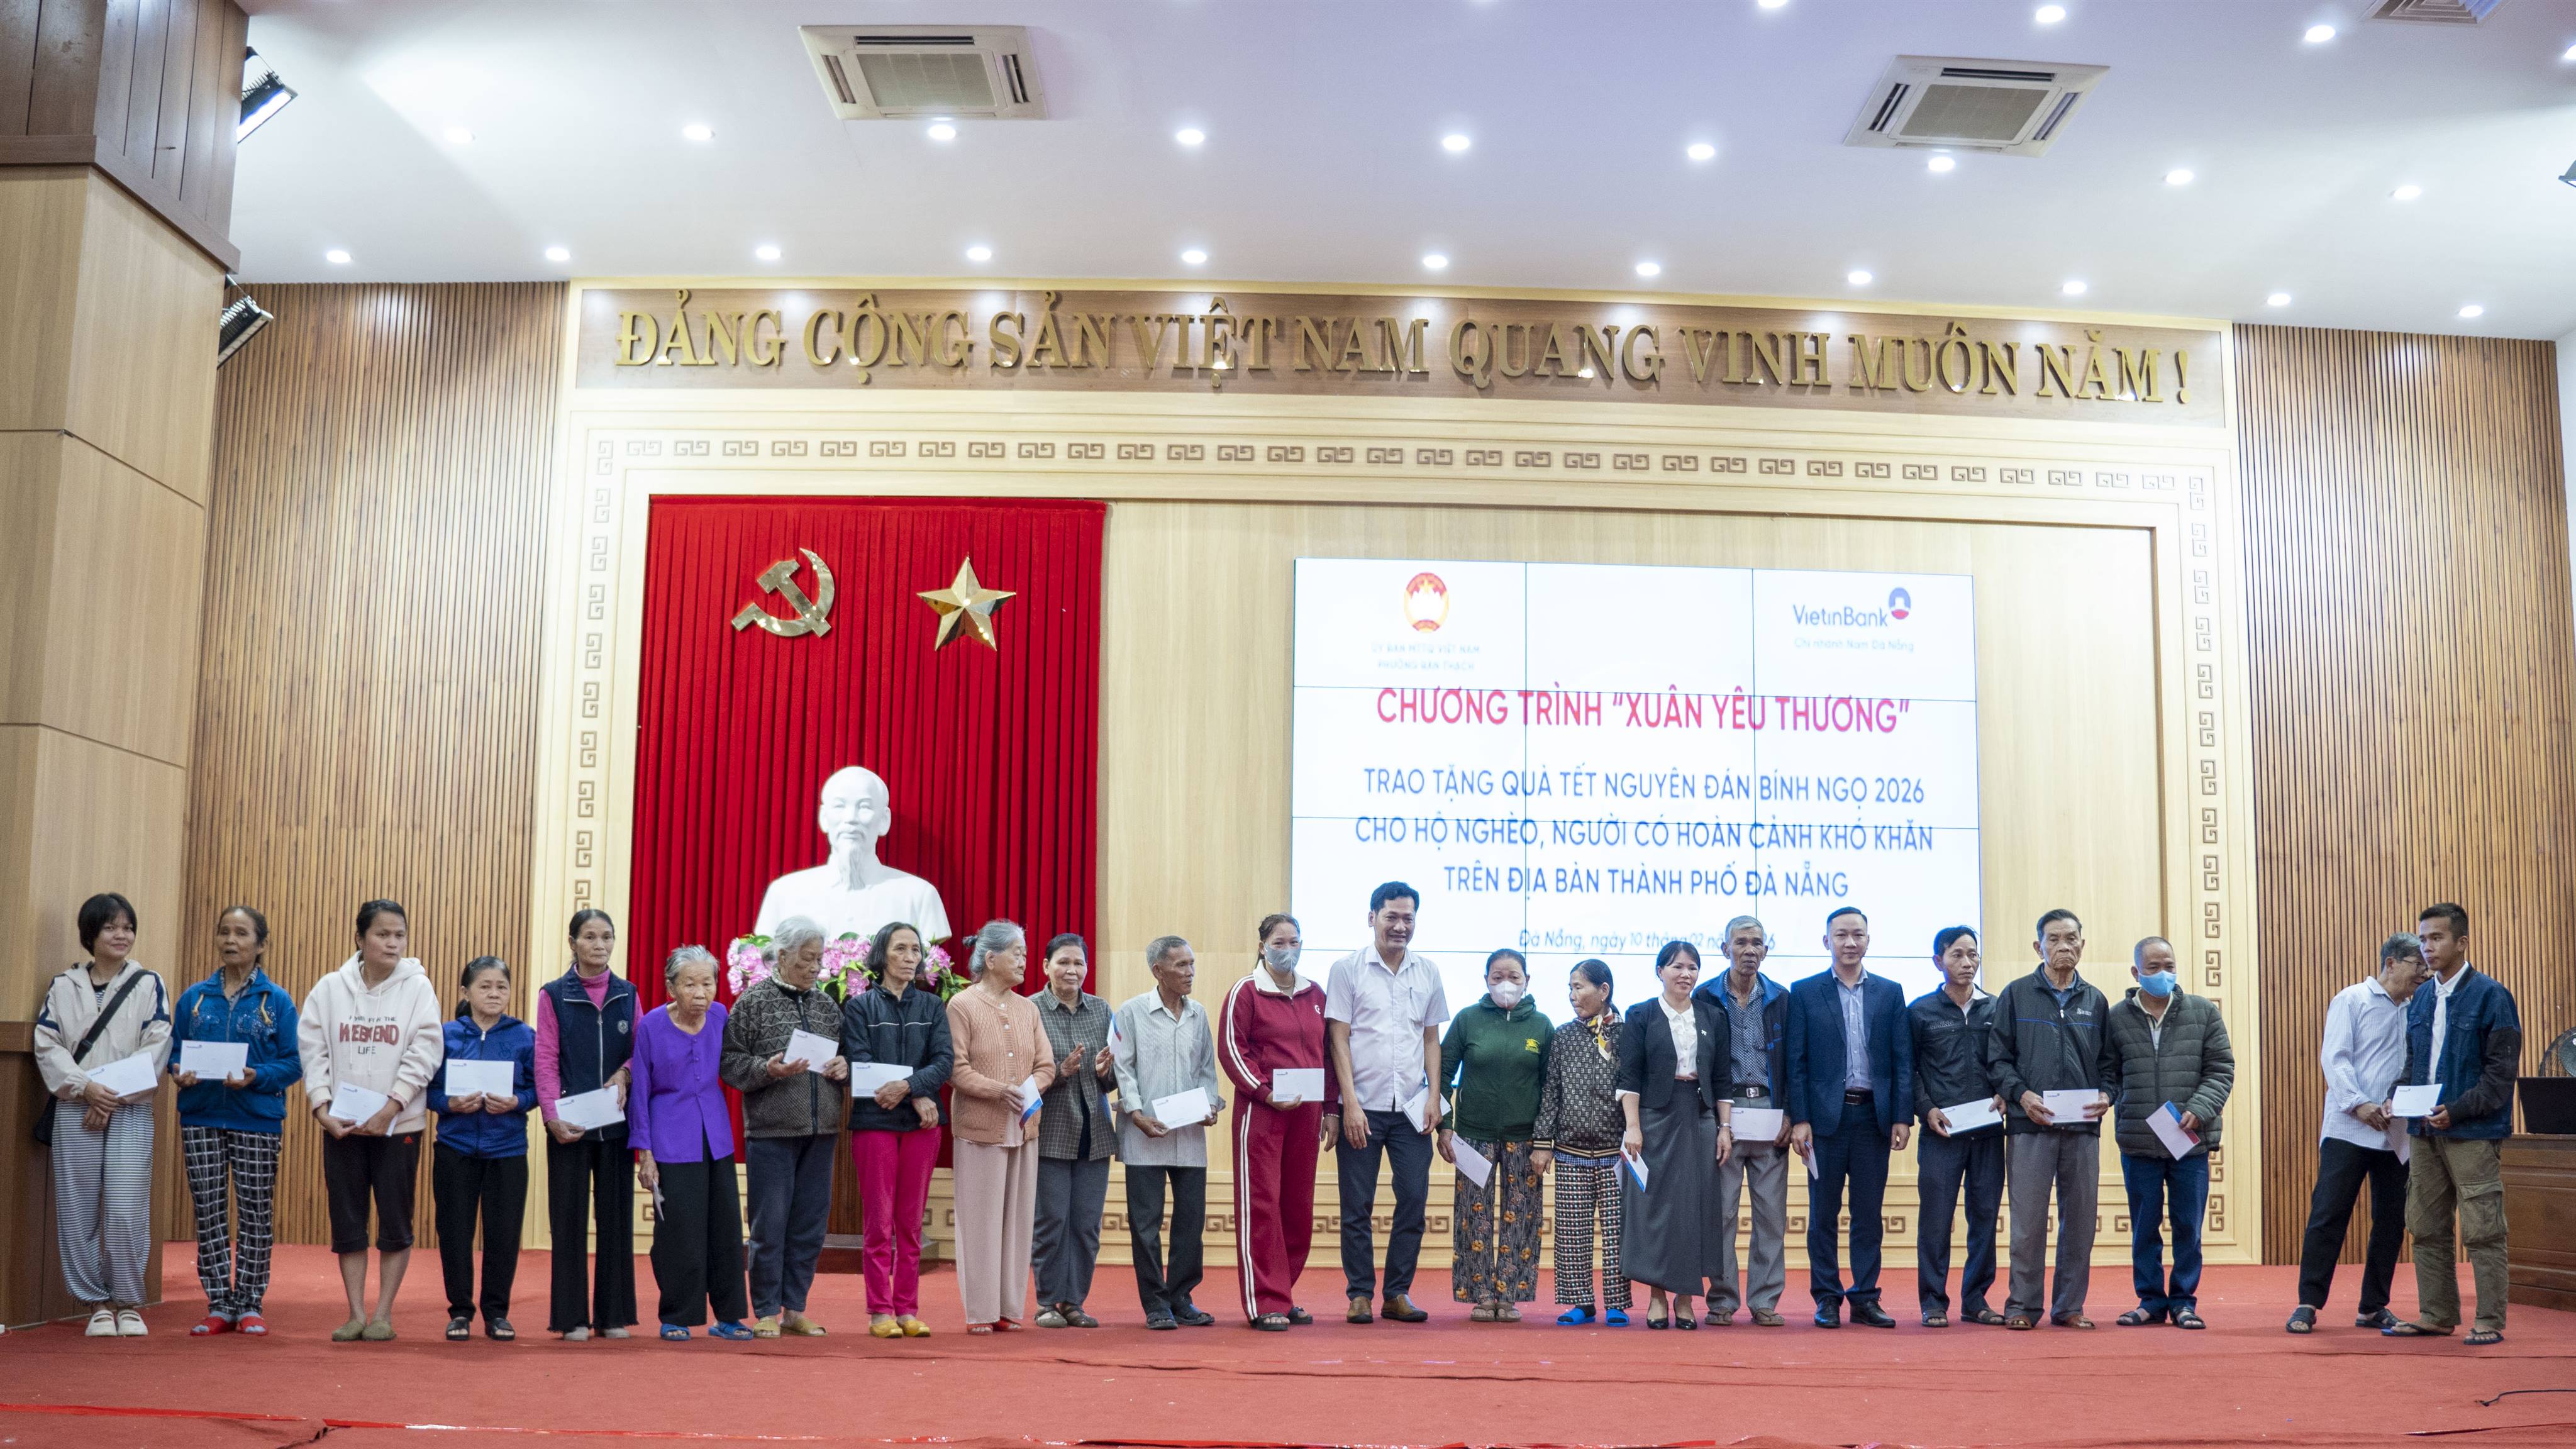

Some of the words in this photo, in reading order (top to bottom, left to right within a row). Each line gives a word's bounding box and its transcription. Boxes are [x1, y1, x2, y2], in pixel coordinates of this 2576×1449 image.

[614, 289, 786, 367] ĐẢNG
[804, 294, 975, 385] CỘNG
[990, 291, 1116, 369] SẢN
[1133, 297, 1276, 387] VIỆT
[1295, 314, 1429, 373] NAM
[1449, 319, 1665, 388] QUANG
[1679, 327, 1831, 387] VINH
[1848, 322, 2020, 395] MUÔN
[2036, 330, 2163, 402] NĂM
[1377, 686, 1508, 724] CHƯƠNG
[1518, 681, 1601, 726] TRÌNH
[1712, 686, 1765, 730] YÊU
[1364, 769, 1424, 794] TRAO
[1433, 764, 1494, 802] TẶNG
[1502, 764, 1552, 796] QUÀ
[1560, 762, 1596, 797] TẾT
[1605, 767, 1695, 799] NGUYÊN
[1704, 768, 1750, 800] ĐÁN
[1760, 769, 1809, 801] BÍNH
[1818, 777, 1867, 809] NGỌ
[1875, 777, 1924, 803] 2026
[1356, 816, 1406, 843] CHO
[1415, 811, 1448, 851] HỘ
[1456, 811, 1544, 850] NGHÈO,
[1553, 813, 1626, 846] NGƯỜI
[1635, 814, 1668, 847] CÓ
[1677, 816, 1741, 848] HOÀN
[1749, 814, 1811, 849] CẢNH
[1821, 818, 1867, 850] KHÓ
[1875, 819, 1933, 851] KHĂN
[1444, 860, 1499, 892] TRÊN
[1508, 867, 1547, 901] ĐỊA
[1555, 862, 1599, 893] BÀN
[1608, 862, 1682, 894] THÀNH
[1691, 861, 1737, 896] PHỐ
[1745, 864, 1777, 897] ĐÀ
[1785, 860, 1849, 897] NẴNG
[1519, 929, 1540, 947] Đà
[1591, 931, 1626, 952] ngày
[1630, 932, 1643, 946] 10
[358, 1046, 376, 1055] LIFE
